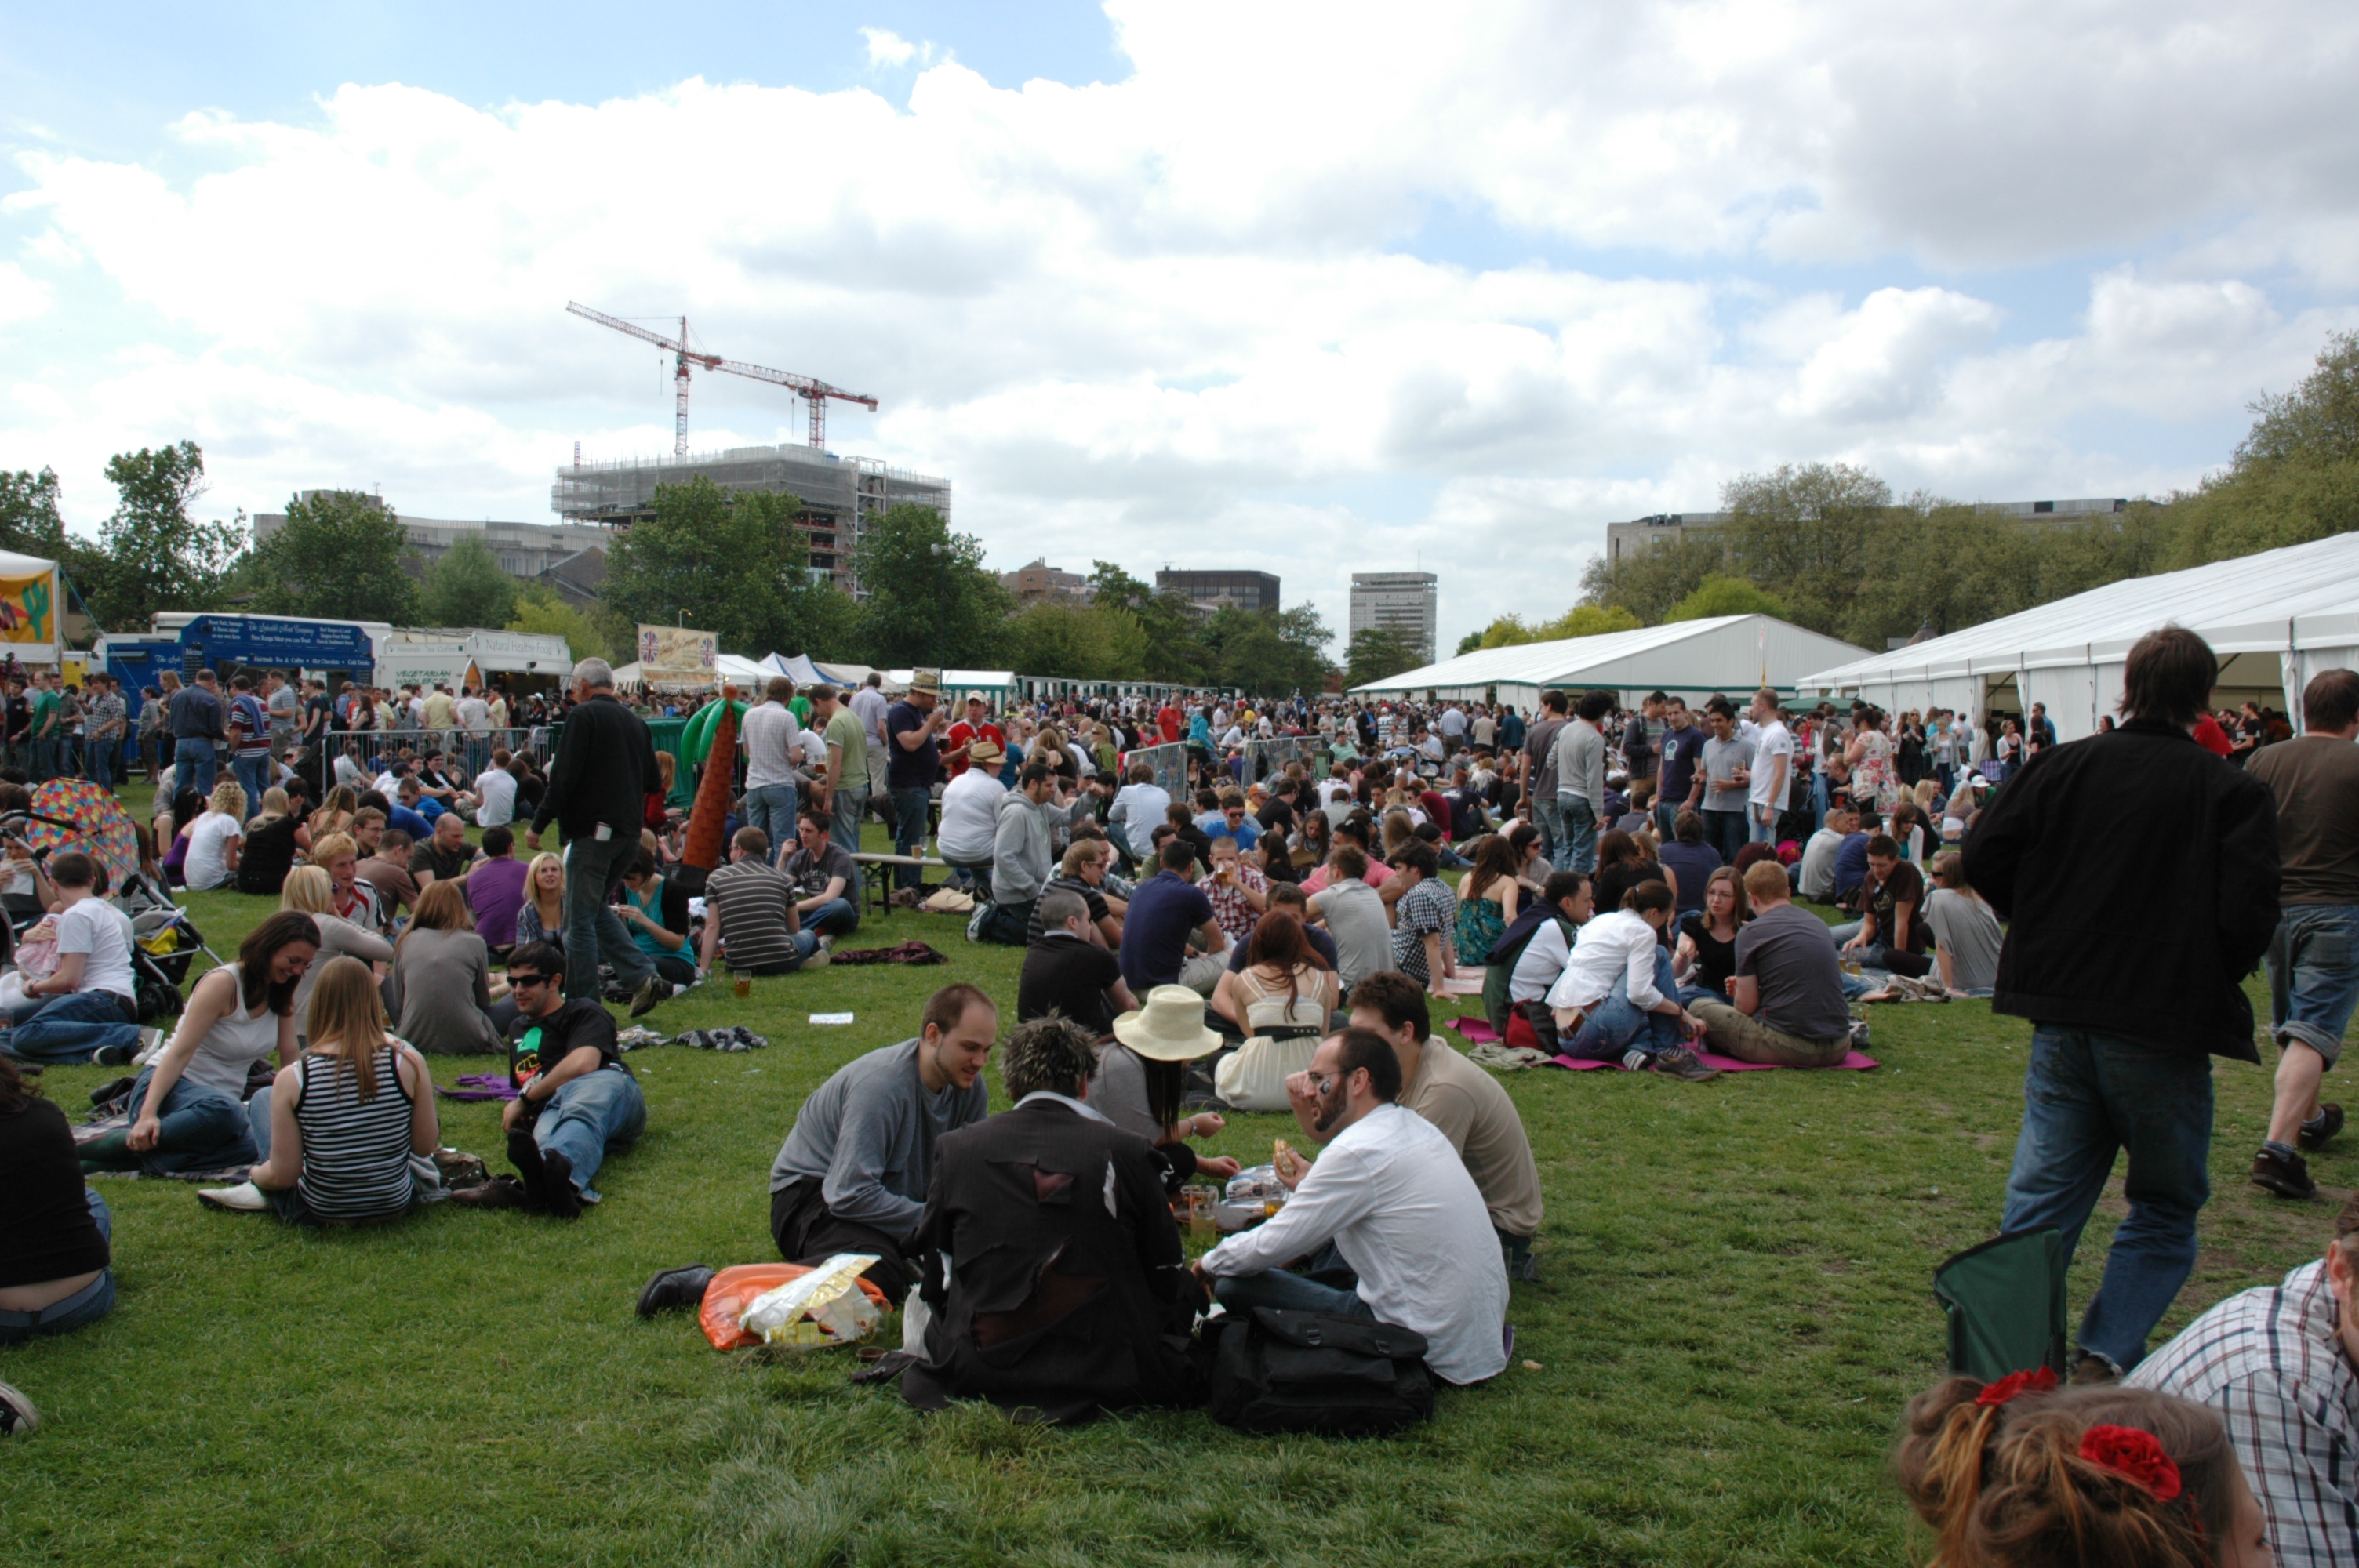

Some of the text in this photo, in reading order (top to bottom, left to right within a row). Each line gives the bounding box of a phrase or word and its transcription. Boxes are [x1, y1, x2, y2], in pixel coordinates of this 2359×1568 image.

[247, 621, 258, 632] The
[485, 638, 552, 656] Natural Healthy Food
[185, 648, 202, 656] Menu
[154, 655, 167, 663] The
